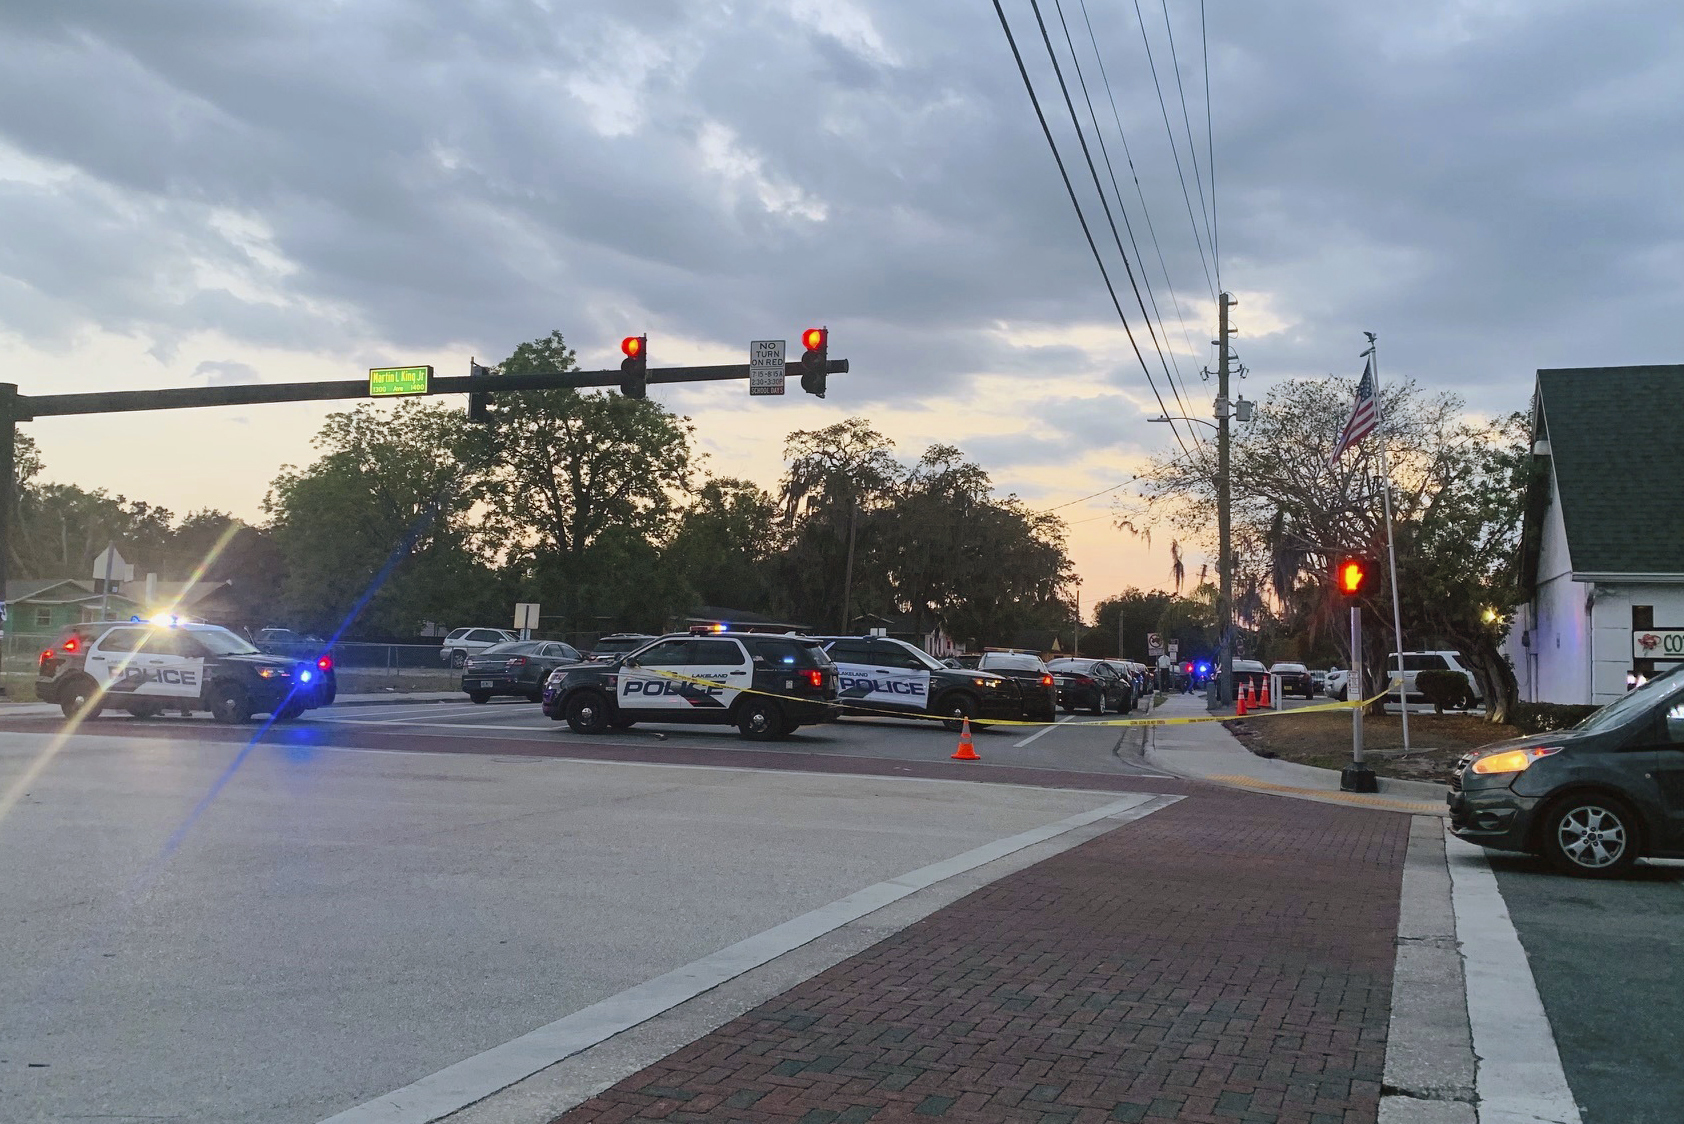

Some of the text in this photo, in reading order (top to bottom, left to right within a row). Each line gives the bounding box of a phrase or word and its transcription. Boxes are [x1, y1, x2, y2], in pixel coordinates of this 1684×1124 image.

[759, 342, 776, 350] NO
[756, 350, 780, 358] TURN
[765, 358, 784, 366] RED
[373, 371, 395, 383] Martin
[400, 370, 416, 384] King
[416, 370, 425, 381] Jr
[410, 383, 425, 391] 1400
[1663, 634, 1684, 653] CO
[107, 665, 197, 686] POLICE
[622, 680, 727, 696] POLICE
[839, 677, 926, 696] POLICE
